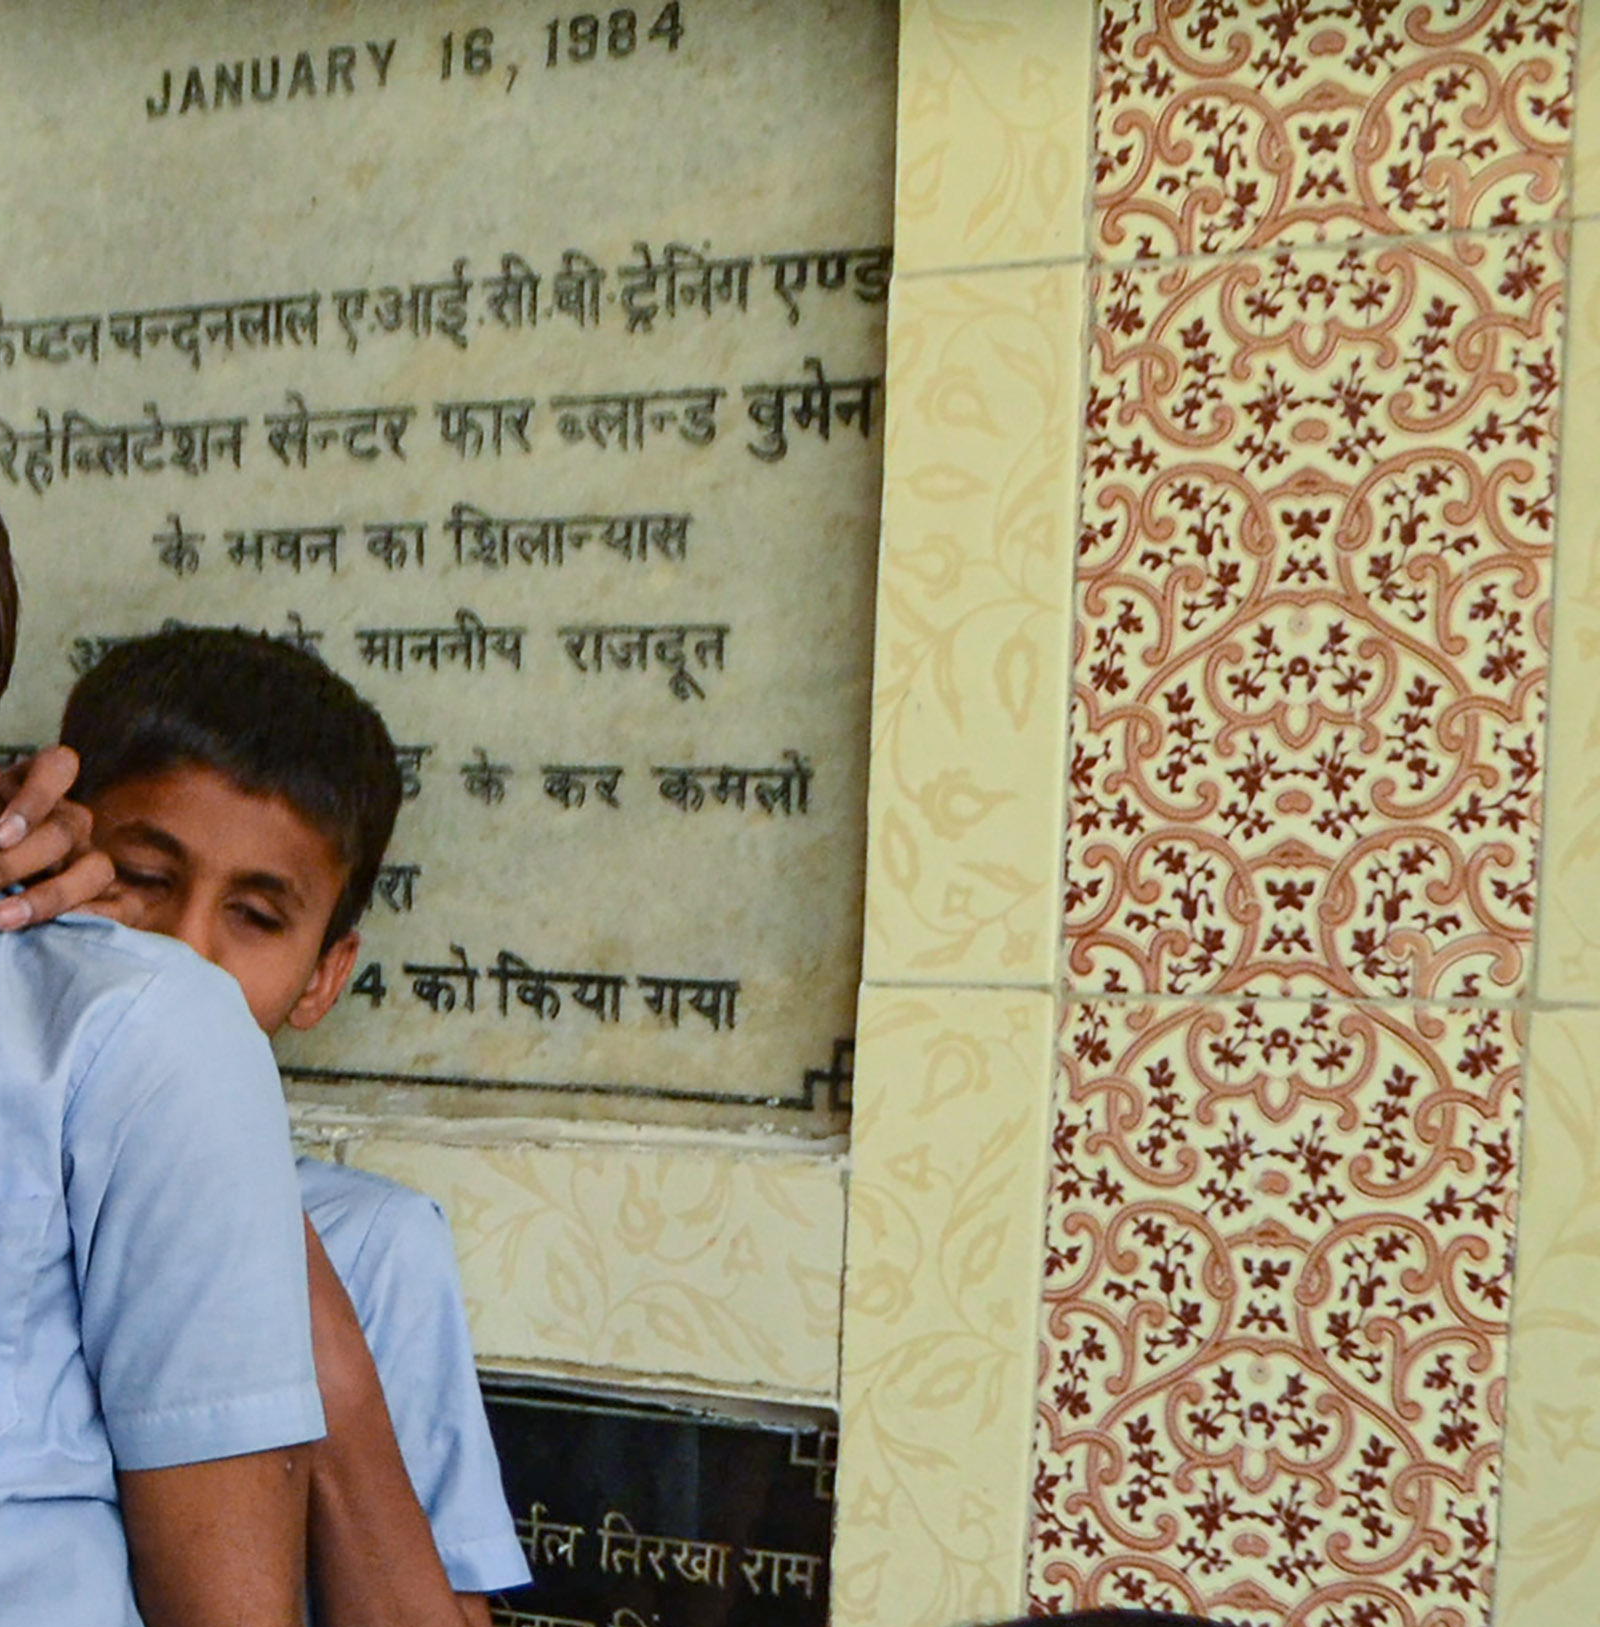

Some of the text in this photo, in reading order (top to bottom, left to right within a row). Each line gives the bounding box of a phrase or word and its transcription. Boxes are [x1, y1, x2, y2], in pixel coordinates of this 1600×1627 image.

[145, 0, 685, 119] JANUARY 16, 1984
[108, 289, 321, 371] चन्दनलाल
[617, 238, 754, 335] ट्रेनिंग
[264, 389, 417, 470] सेन्टर
[433, 396, 536, 459] फार
[152, 501, 694, 577] के भवन का शिलान्यास
[354, 606, 528, 673] माननीय
[556, 623, 732, 700] राजदूत
[459, 746, 513, 807] के
[540, 764, 625, 810] कर
[402, 941, 480, 1015] को
[487, 947, 627, 1023] किया
[637, 974, 742, 1032] गया
[597, 1509, 733, 1589] तिरखा
[739, 1546, 826, 1600] राम
